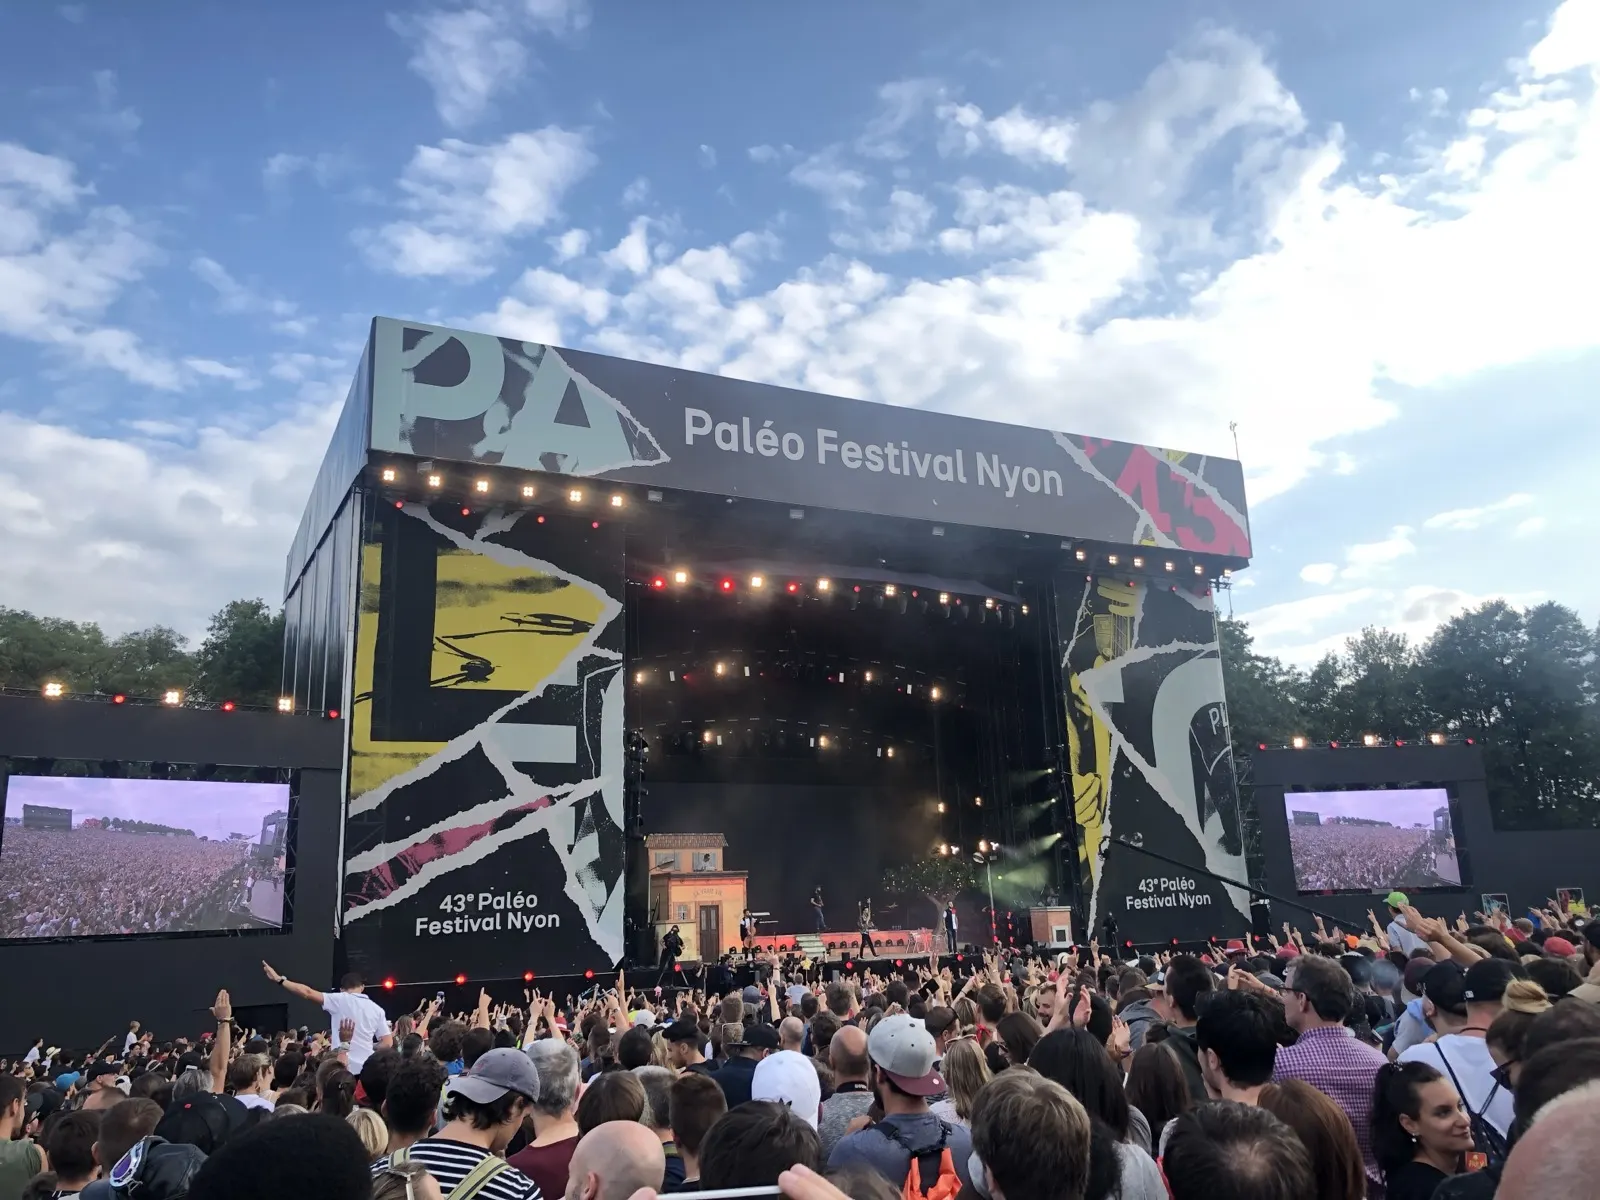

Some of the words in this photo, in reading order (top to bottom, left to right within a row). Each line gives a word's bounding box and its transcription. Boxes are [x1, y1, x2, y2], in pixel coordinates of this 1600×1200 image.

[684, 406, 805, 461] Paléo
[816, 428, 967, 484] Festival
[976, 451, 1064, 498] Nyon
[1160, 876, 1196, 892] Paléo
[478, 890, 538, 911] Paléo
[1125, 893, 1177, 910] Festival
[1179, 892, 1212, 909] Nyon
[415, 912, 502, 937] Festival
[507, 911, 560, 933] Nyon
